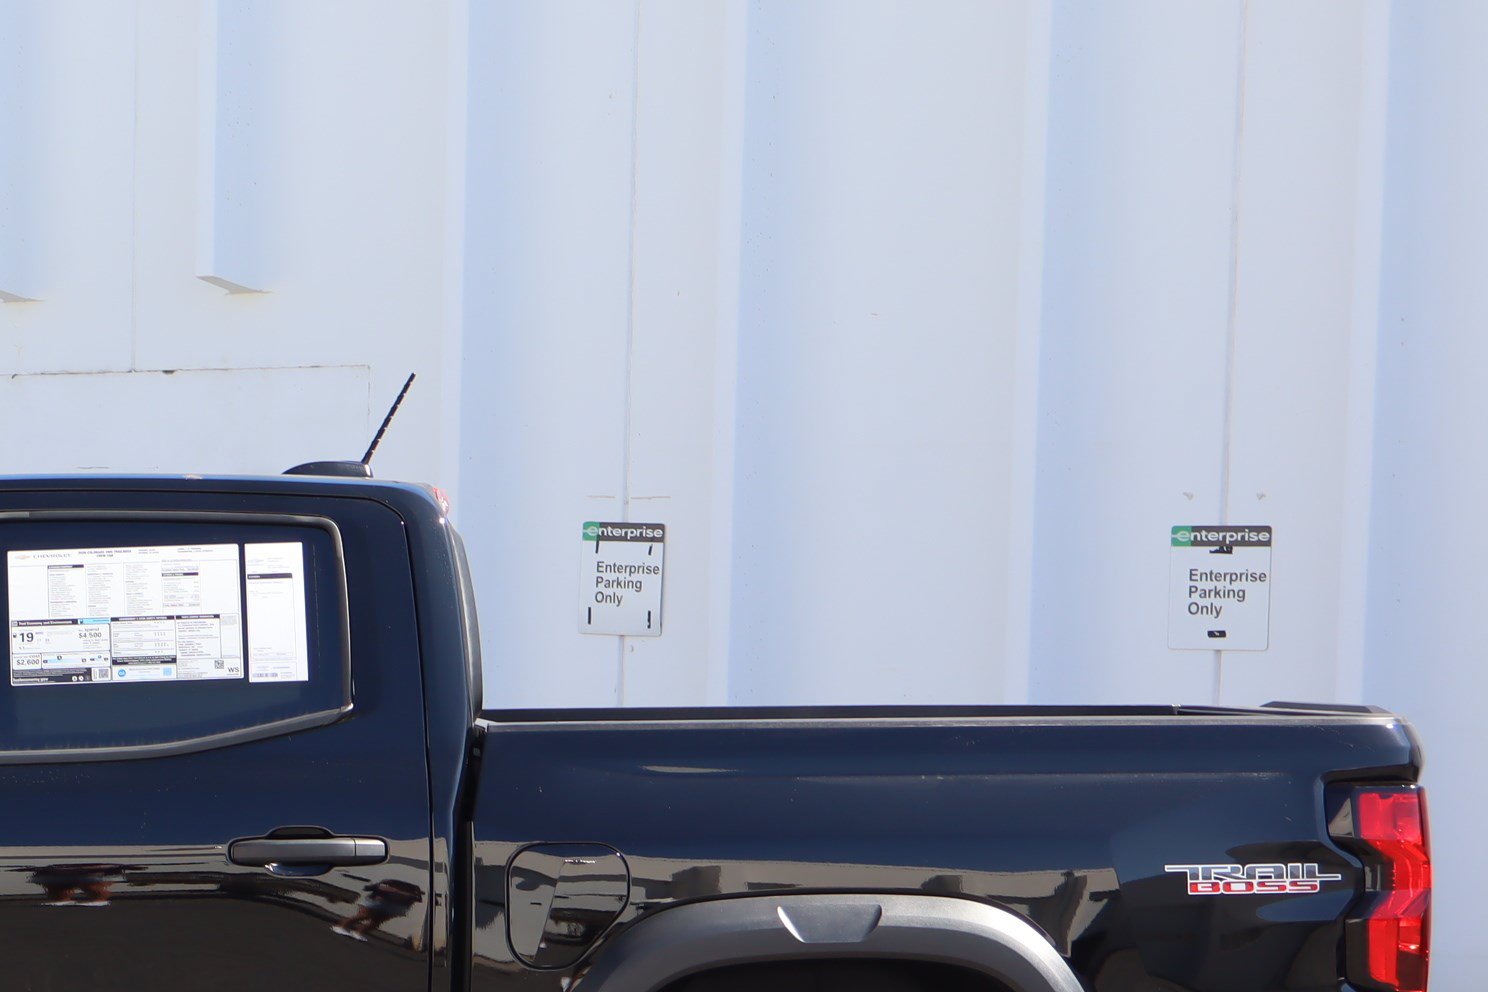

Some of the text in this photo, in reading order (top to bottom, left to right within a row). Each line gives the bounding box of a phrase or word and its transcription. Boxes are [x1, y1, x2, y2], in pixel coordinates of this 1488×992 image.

[583, 526, 663, 539] enterprise
[1172, 528, 1270, 544] enterprise
[596, 561, 660, 577] Enterprise
[1189, 568, 1267, 585] Enterprise
[595, 576, 643, 593] Parking
[594, 591, 623, 607] Only
[1188, 585, 1246, 602] Parking
[1187, 602, 1223, 619] Only
[19, 632, 34, 642] 19
[1164, 863, 1342, 880] TRAIL
[1187, 879, 1320, 895] BOSS
